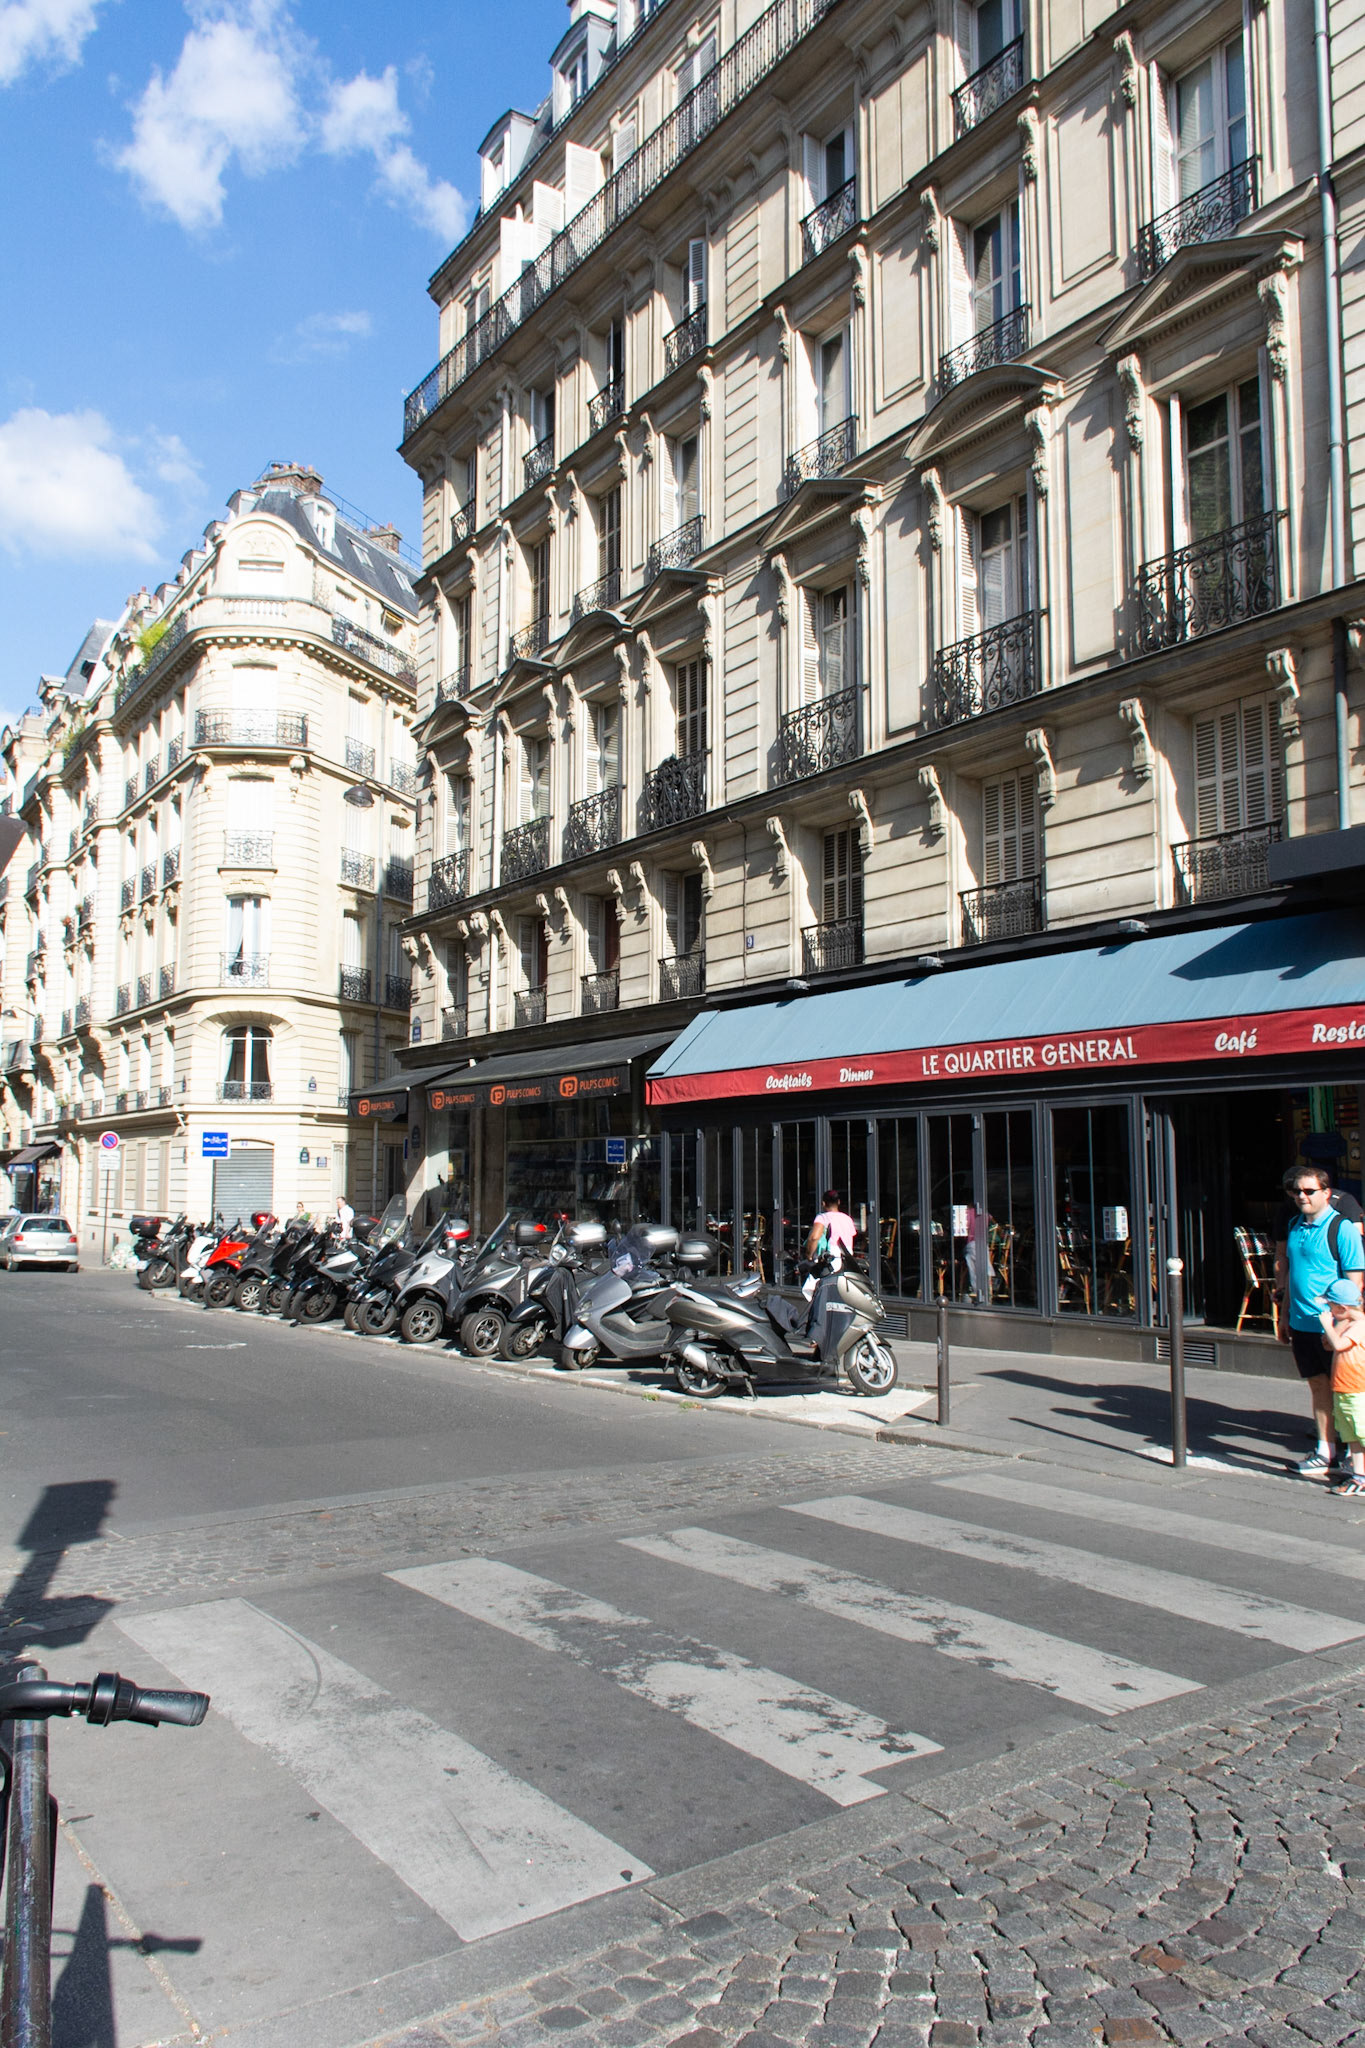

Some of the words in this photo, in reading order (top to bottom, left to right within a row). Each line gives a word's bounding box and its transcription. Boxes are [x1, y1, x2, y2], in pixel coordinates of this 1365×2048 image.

[1214, 1028, 1258, 1054] Café
[922, 1055, 939, 1076] LE
[944, 1045, 1036, 1074] QUARTIER
[1041, 1036, 1138, 1066] GENERAL
[765, 1072, 813, 1090] Cocktails
[839, 1067, 875, 1083] Dinner
